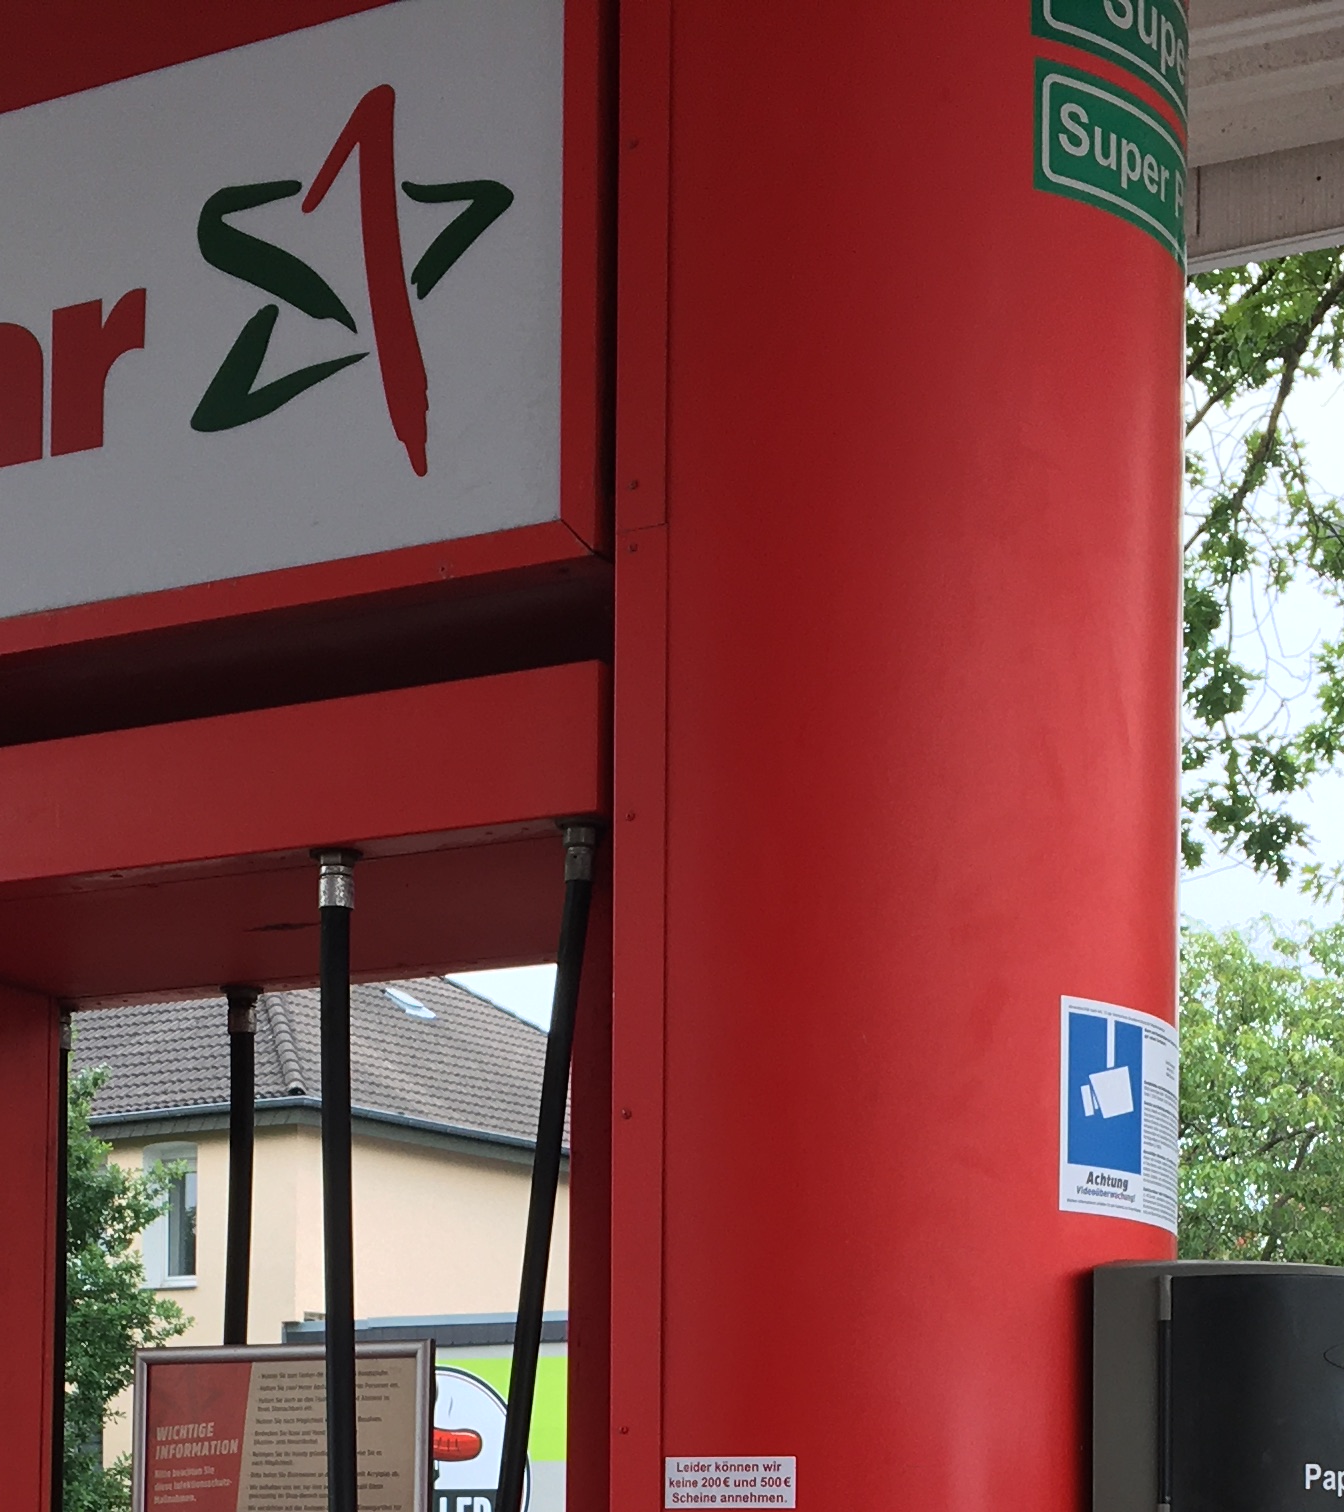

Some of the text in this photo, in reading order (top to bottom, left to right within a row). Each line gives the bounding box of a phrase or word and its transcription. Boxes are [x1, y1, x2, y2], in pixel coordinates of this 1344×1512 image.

[1103, 0, 1186, 85] Supe
[1058, 102, 1169, 202] Super
[1086, 1171, 1129, 1192] Achtung
[156, 1422, 215, 1441] WICHTIGE
[155, 1439, 238, 1460] INFORMATION
[676, 1460, 782, 1473] Leider können wir
[669, 1477, 698, 1488] keine
[734, 1477, 757, 1488] und
[672, 1492, 788, 1504] Scheine annehmen.
